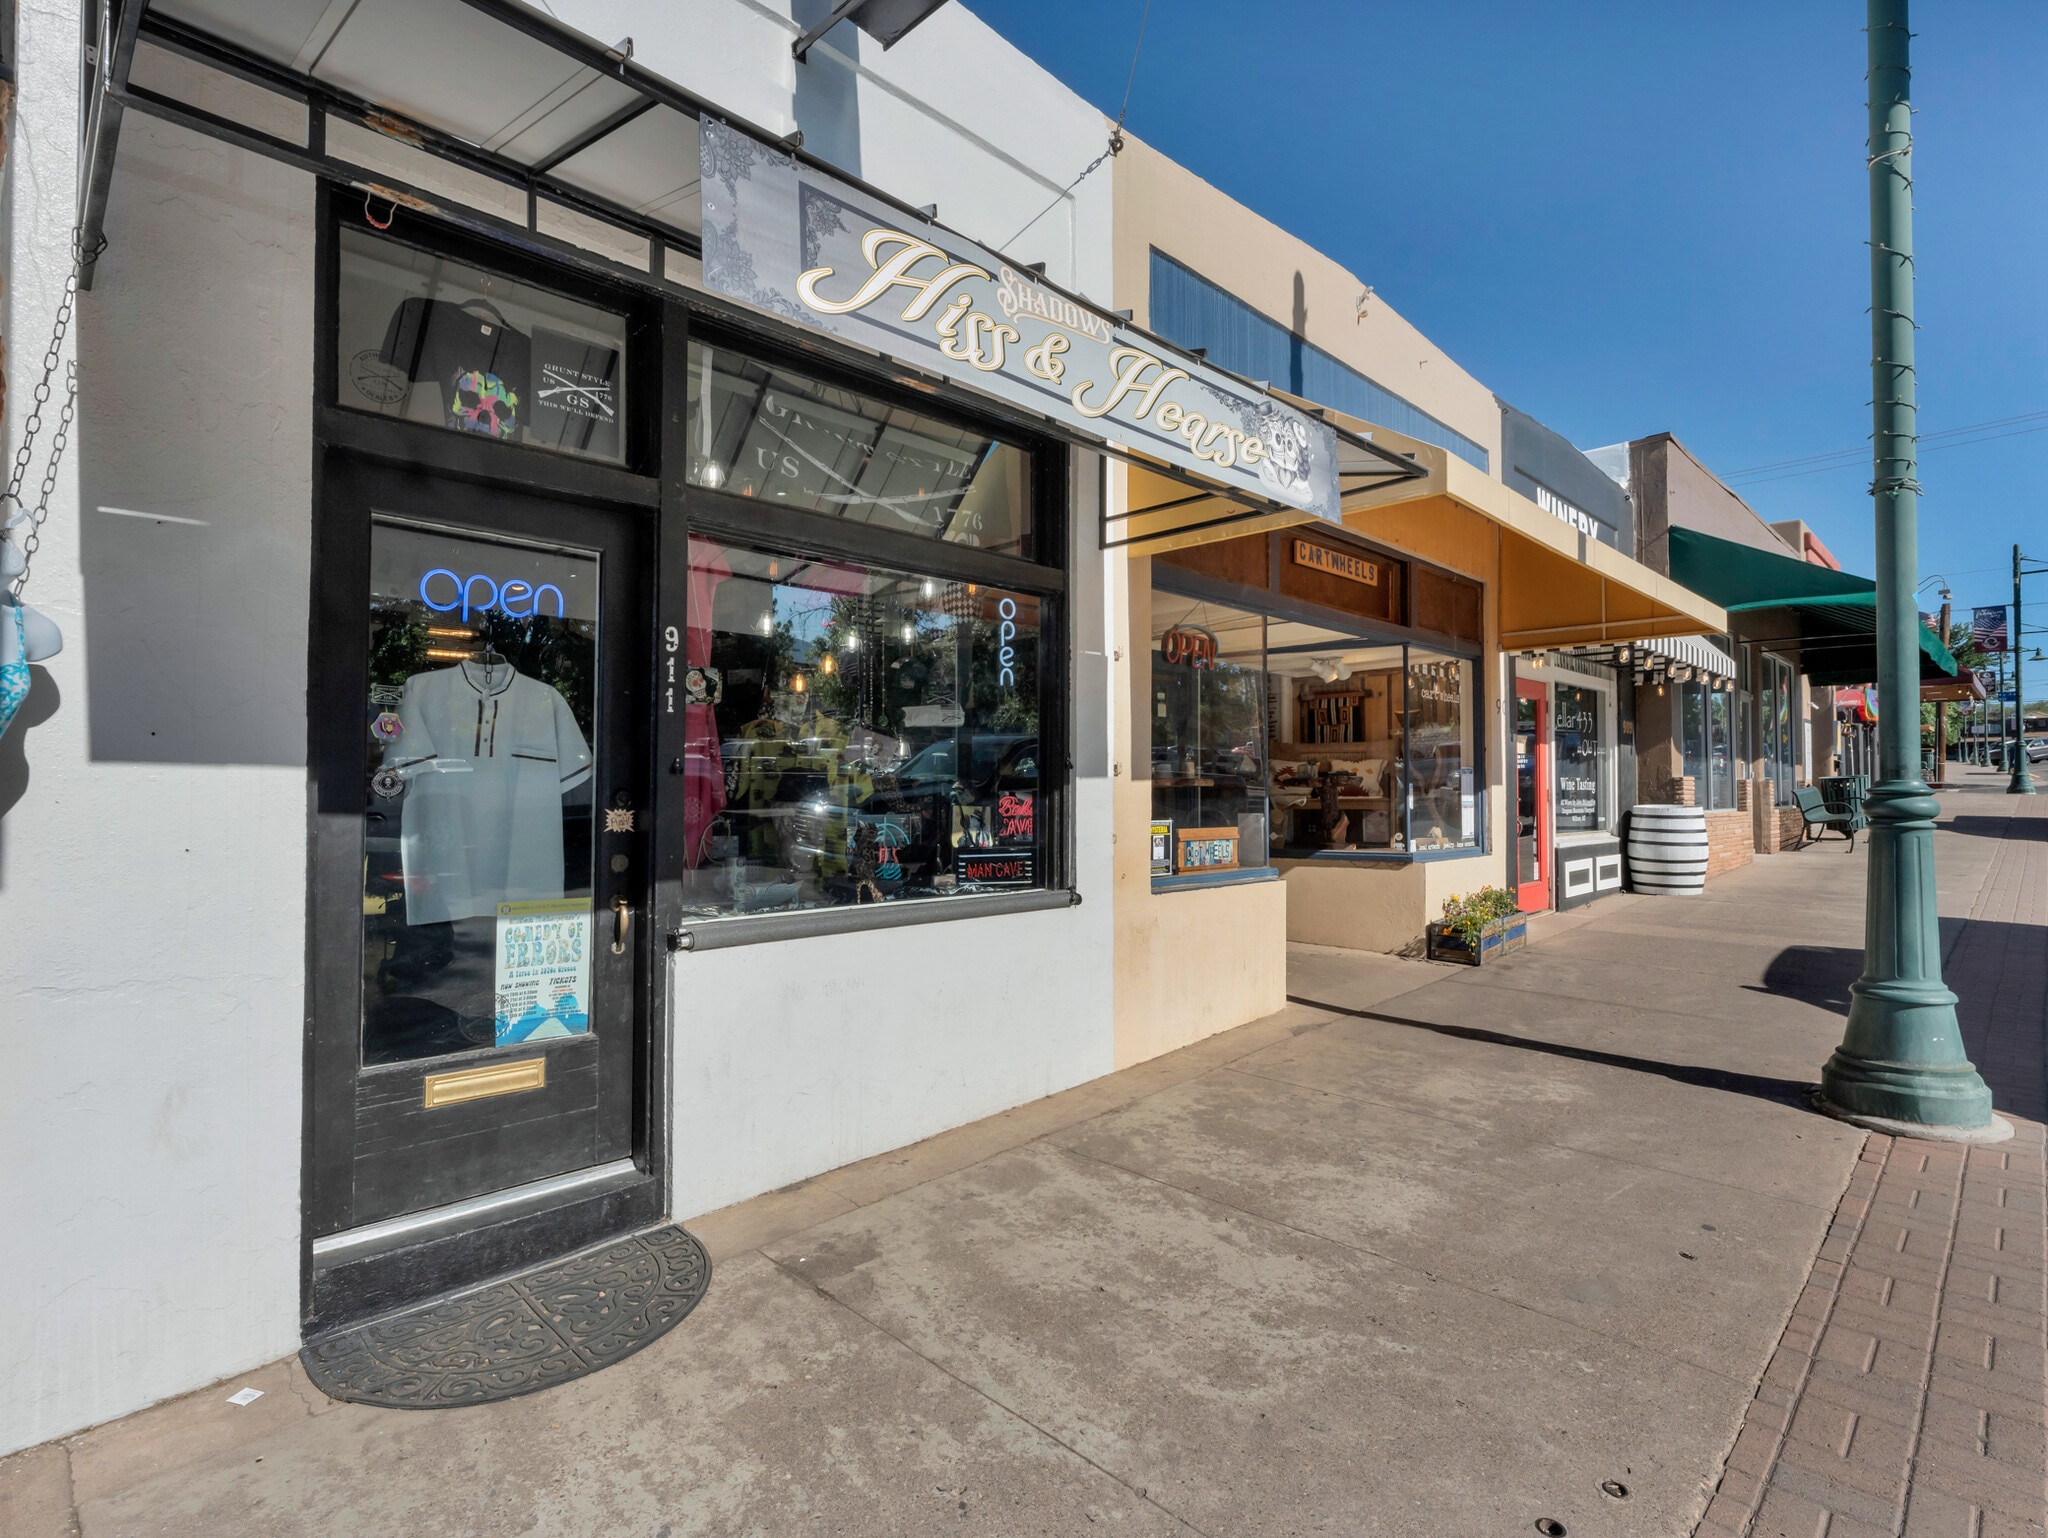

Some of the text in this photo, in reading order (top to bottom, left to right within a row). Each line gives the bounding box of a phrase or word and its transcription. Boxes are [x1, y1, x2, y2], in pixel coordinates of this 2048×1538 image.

[796, 228, 1270, 468] Hiss & Hearse
[542, 376, 555, 385] US
[544, 363, 611, 387] GRUNT STYLE
[538, 399, 558, 409] THIS
[566, 394, 590, 409] GS
[756, 446, 983, 531] US 1776
[1299, 543, 1375, 581] CARTWHEELS
[1166, 630, 1217, 671] OPEN
[1555, 702, 1593, 733] ellar 433
[1560, 777, 1596, 794] Wine Tasting
[967, 861, 1024, 878] MAN CAVE
[505, 921, 583, 943] COMEDY OF
[504, 938, 583, 969] ERRORS
[549, 976, 577, 986] TICKETS
